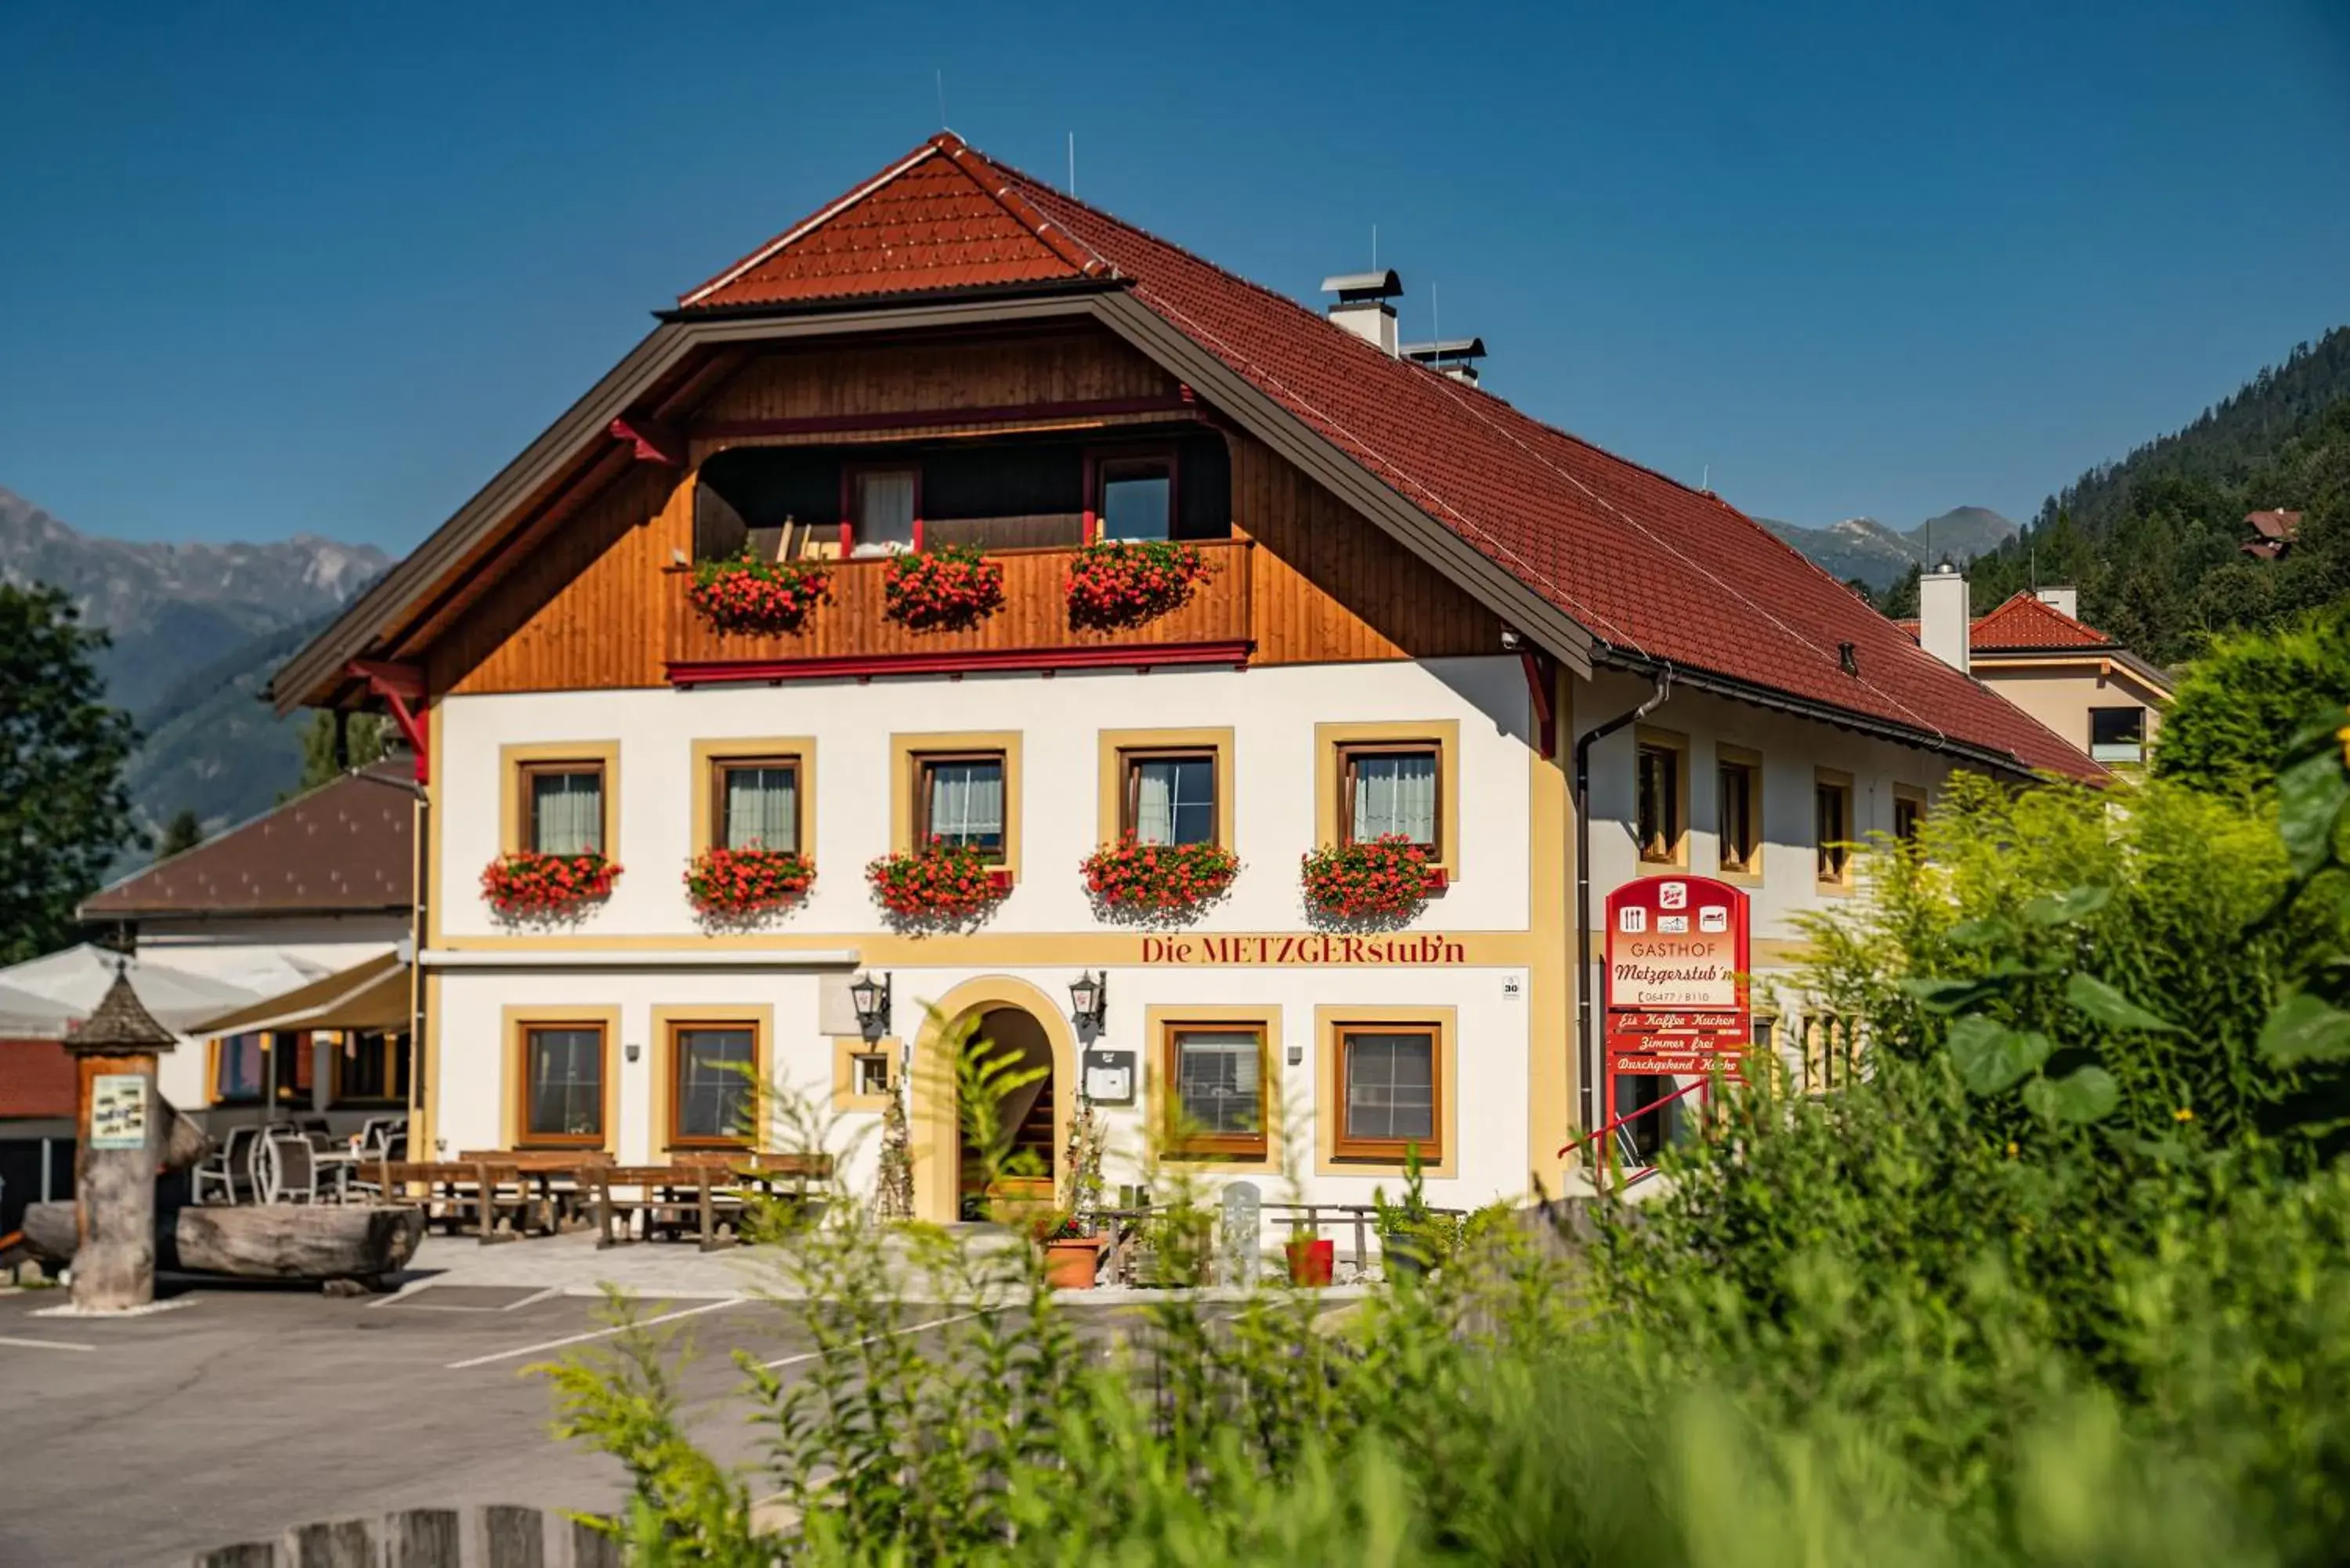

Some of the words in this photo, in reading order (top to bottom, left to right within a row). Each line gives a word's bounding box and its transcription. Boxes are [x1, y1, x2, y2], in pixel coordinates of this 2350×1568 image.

[1142, 936, 1191, 963] Die
[1631, 942, 1716, 957] GASTHOF
[1619, 1013, 1638, 1028] Eis
[1691, 1013, 1735, 1026] Kuchen
[1639, 1036, 1685, 1050] Zimmer
[1690, 1037, 1715, 1051] frei
